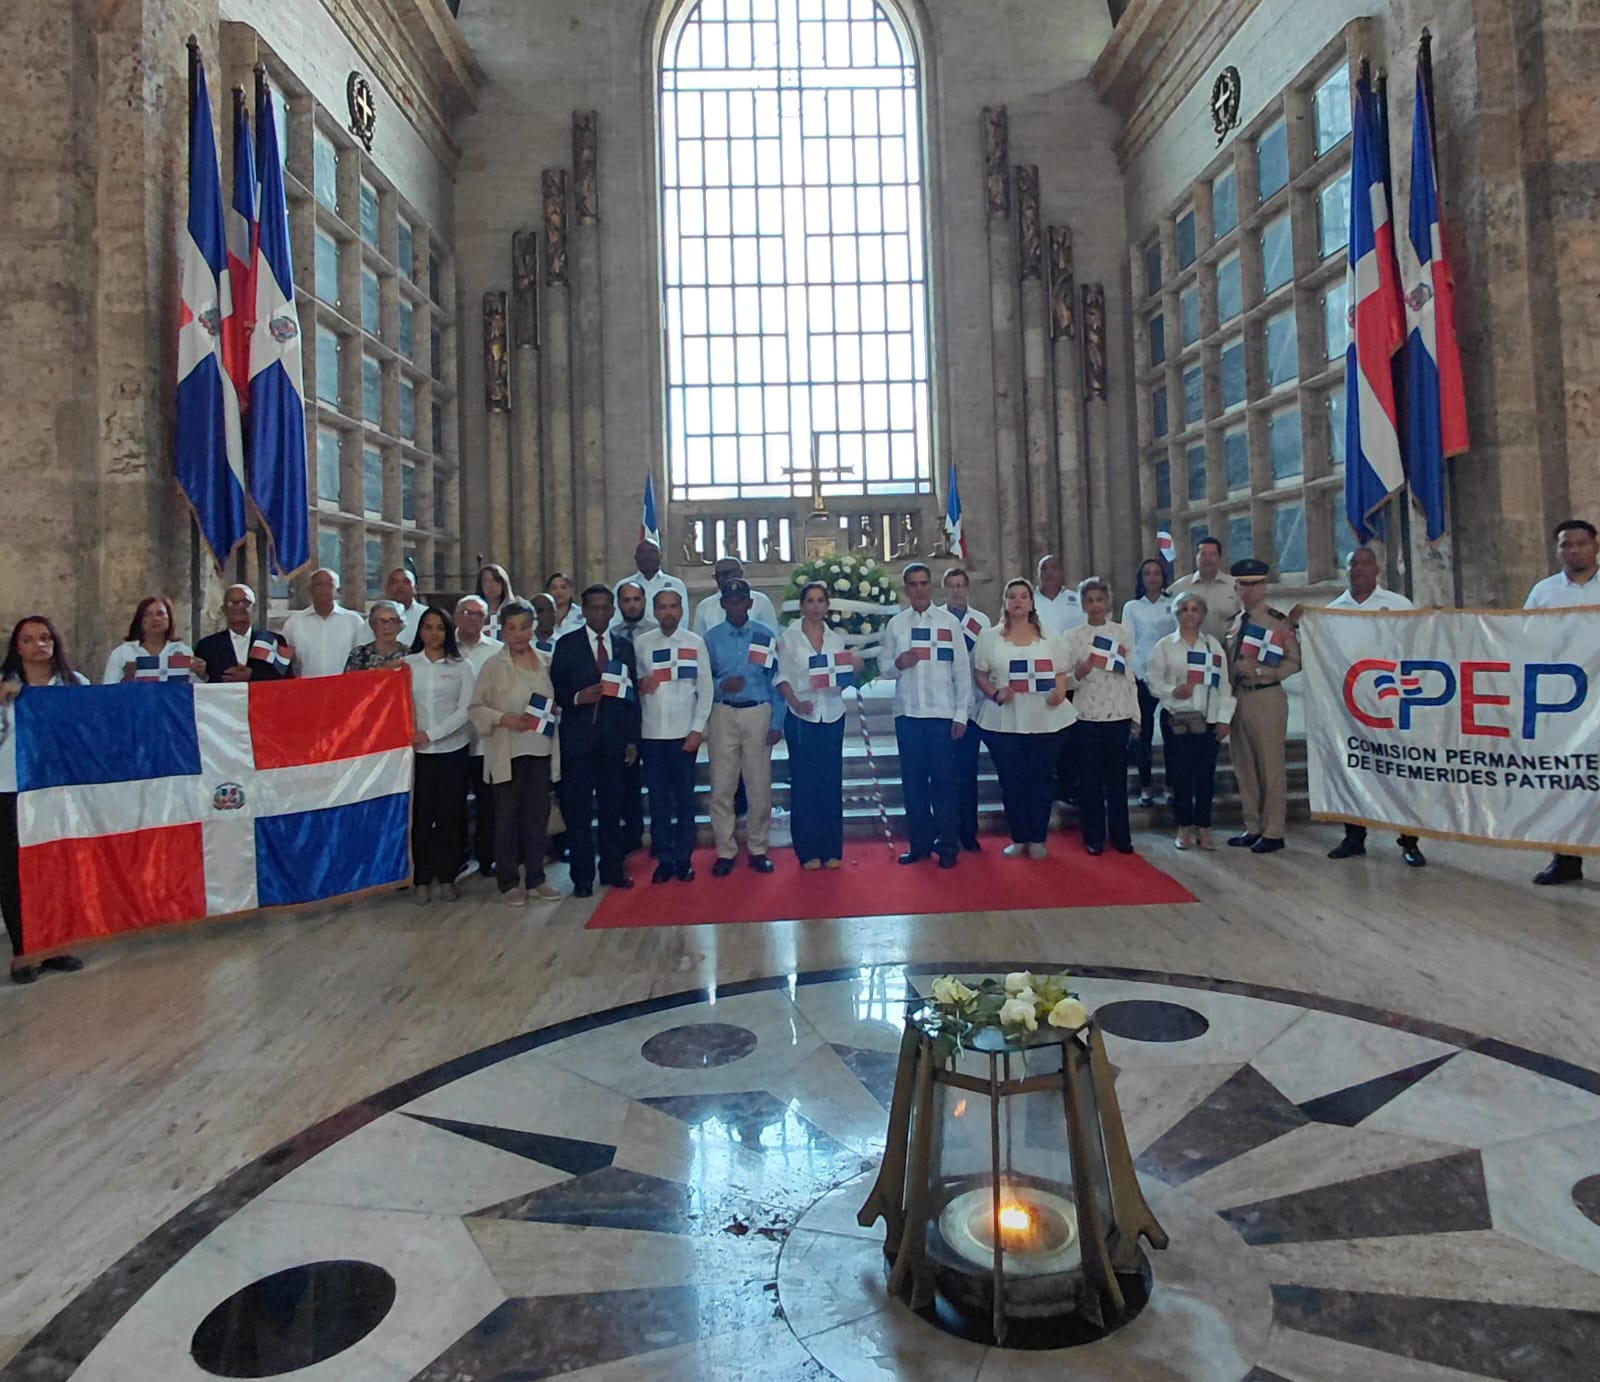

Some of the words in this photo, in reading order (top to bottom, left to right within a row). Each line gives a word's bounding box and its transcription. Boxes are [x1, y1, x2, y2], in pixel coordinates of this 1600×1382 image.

[1343, 659, 1588, 739] CPEP
[1347, 736, 1436, 763] COMISION
[1445, 749, 1598, 770] PERMANENTE
[1347, 753, 1371, 770] DE
[1375, 759, 1498, 786] EFEMERIDES
[1504, 772, 1600, 792] PATRIAS
